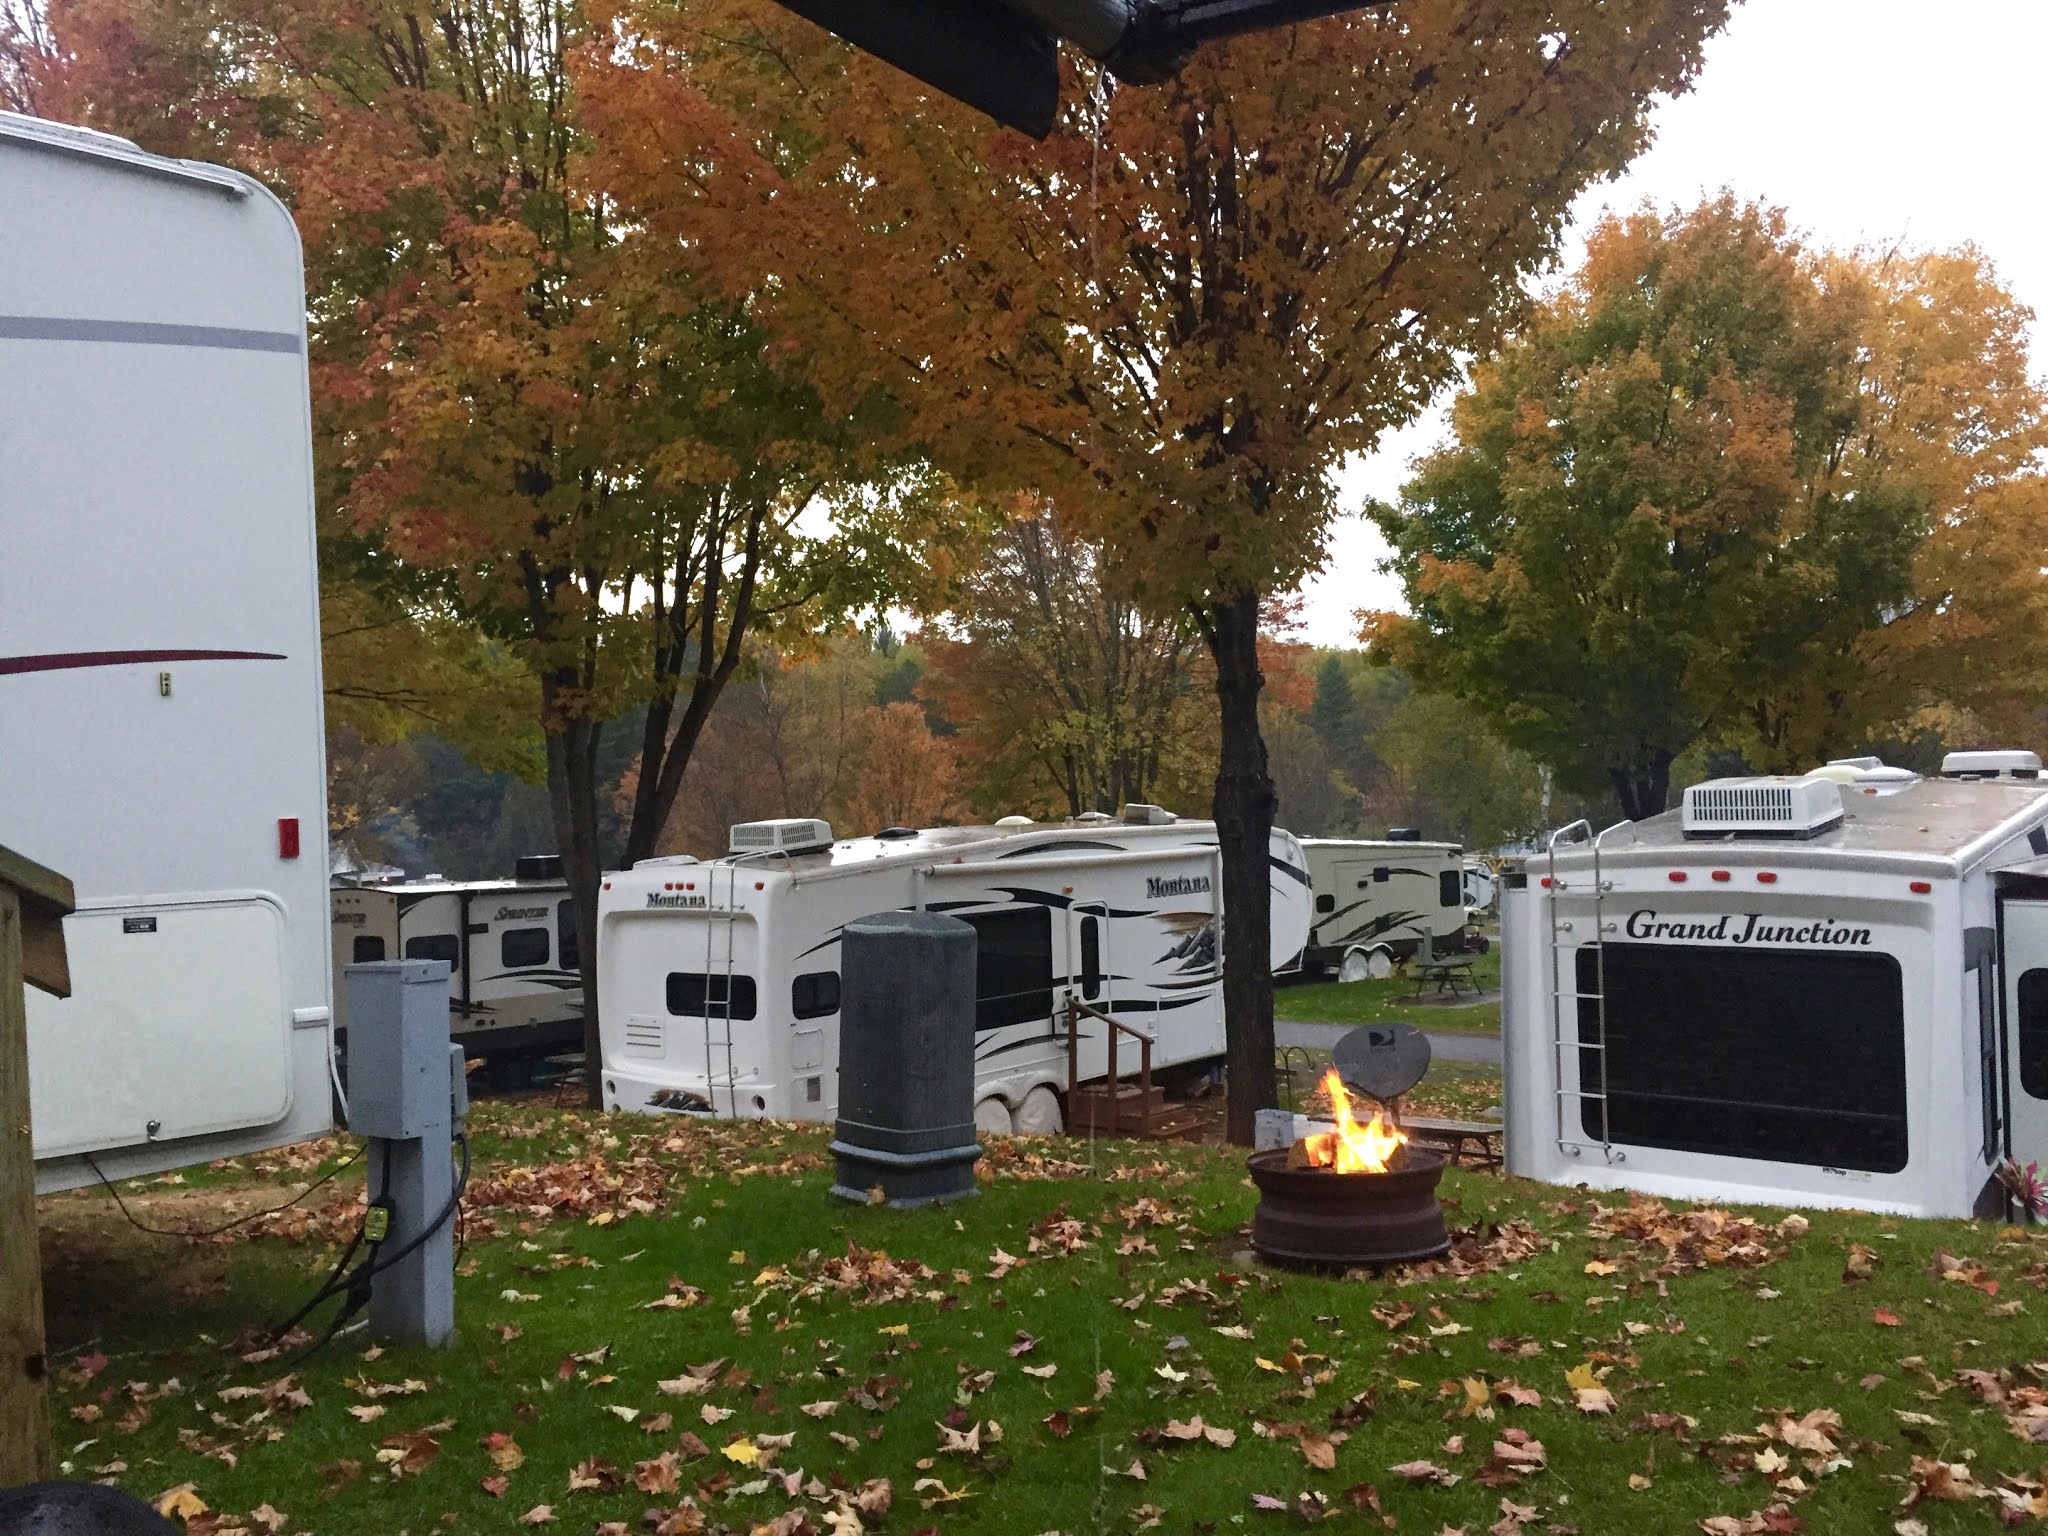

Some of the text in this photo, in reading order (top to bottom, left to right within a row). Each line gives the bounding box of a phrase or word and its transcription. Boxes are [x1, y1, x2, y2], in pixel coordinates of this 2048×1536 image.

[1146, 874, 1210, 899] Montana
[646, 892, 707, 908] Montana
[1626, 909, 1872, 945] Grand Junction
